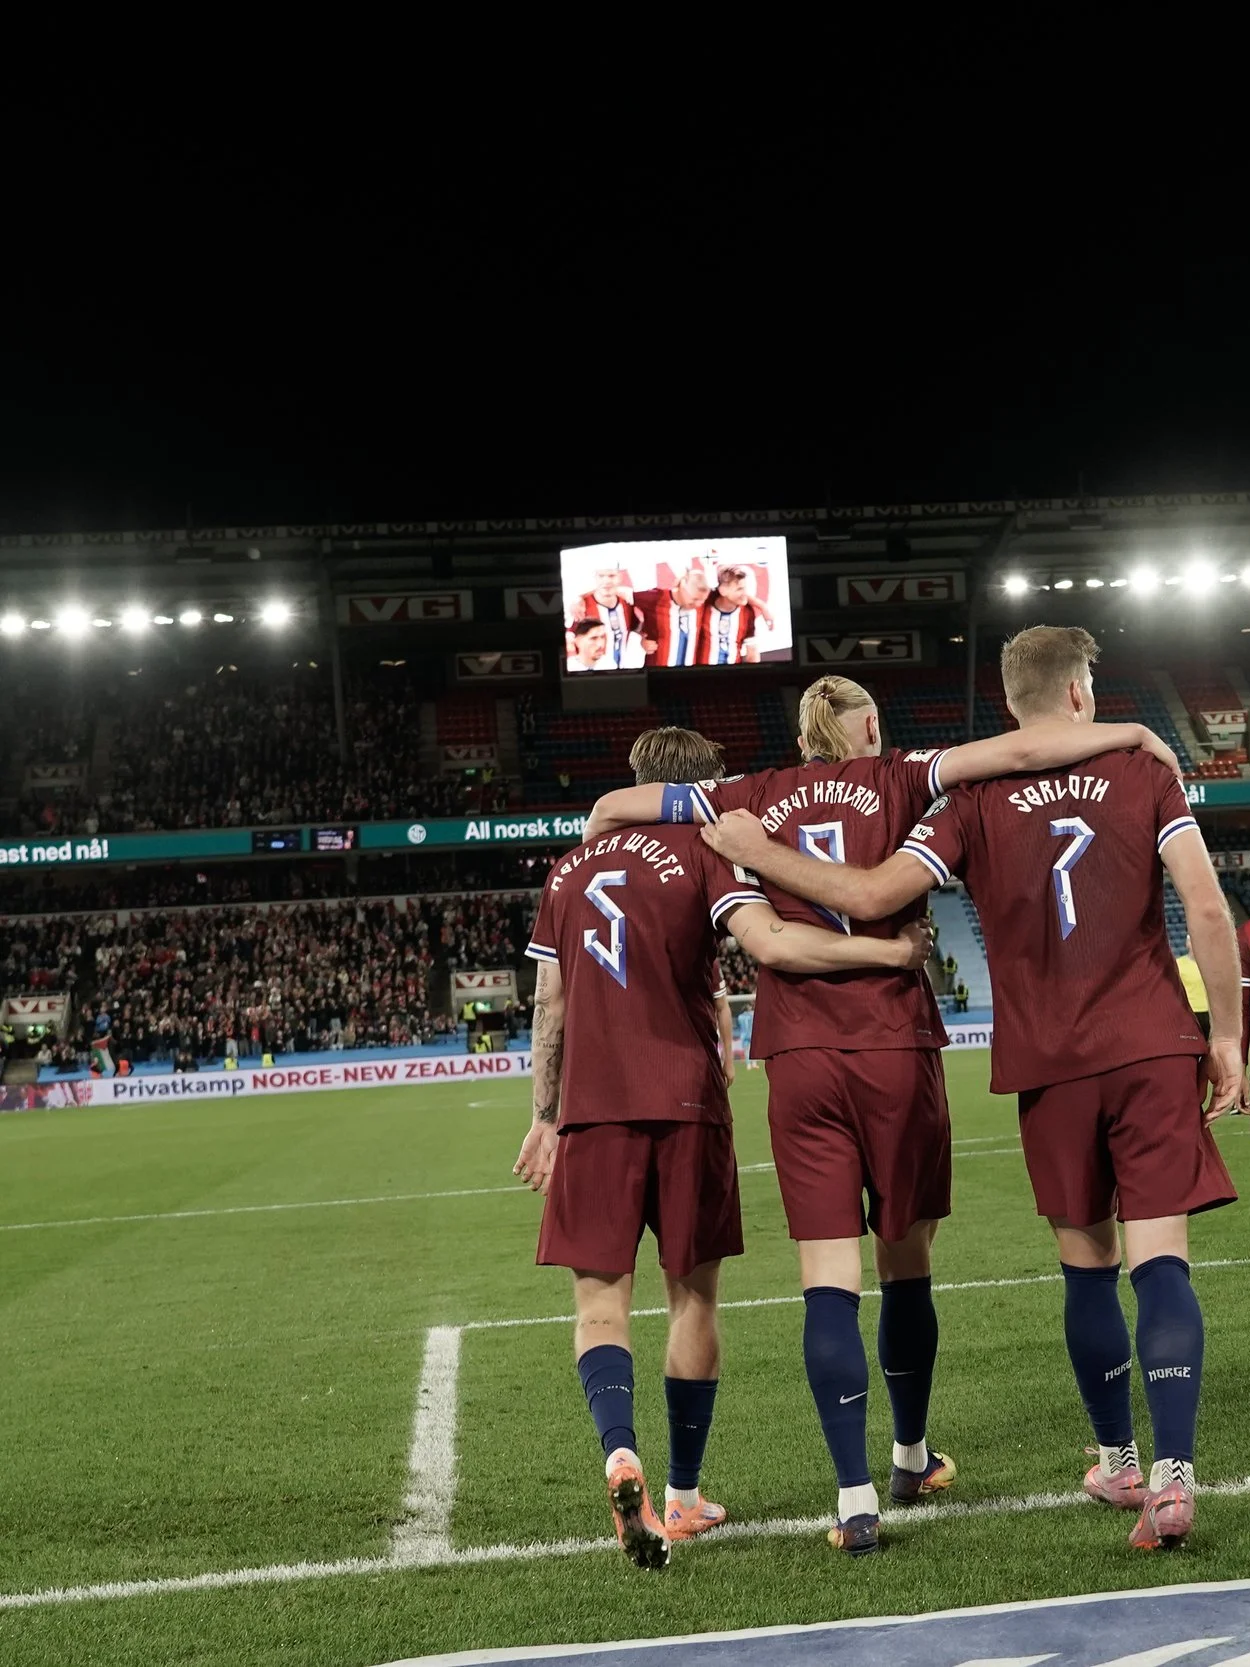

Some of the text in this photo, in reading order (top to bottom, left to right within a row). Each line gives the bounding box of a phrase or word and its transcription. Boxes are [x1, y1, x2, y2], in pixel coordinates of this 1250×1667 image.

[850, 578, 948, 603] VG
[352, 596, 454, 621] VG
[809, 635, 907, 661] VG
[462, 653, 535, 675] VG
[1202, 712, 1245, 724] VG
[447, 748, 491, 760] VG
[32, 766, 80, 779] VG
[465, 821, 491, 841] All
[494, 819, 550, 839] norsk
[32, 841, 72, 862] ned
[75, 838, 109, 860] nå!
[622, 832, 685, 884] WOLFE
[1050, 816, 1095, 940] 7
[584, 869, 627, 988] 5
[456, 974, 511, 988] VG
[9, 1000, 65, 1016] VG
[114, 1074, 245, 1098] Privatkamp
[253, 1065, 397, 1090] NORGE-NEW
[405, 1056, 511, 1079] ZEALAND
[1148, 1366, 1192, 1382] NORGE
